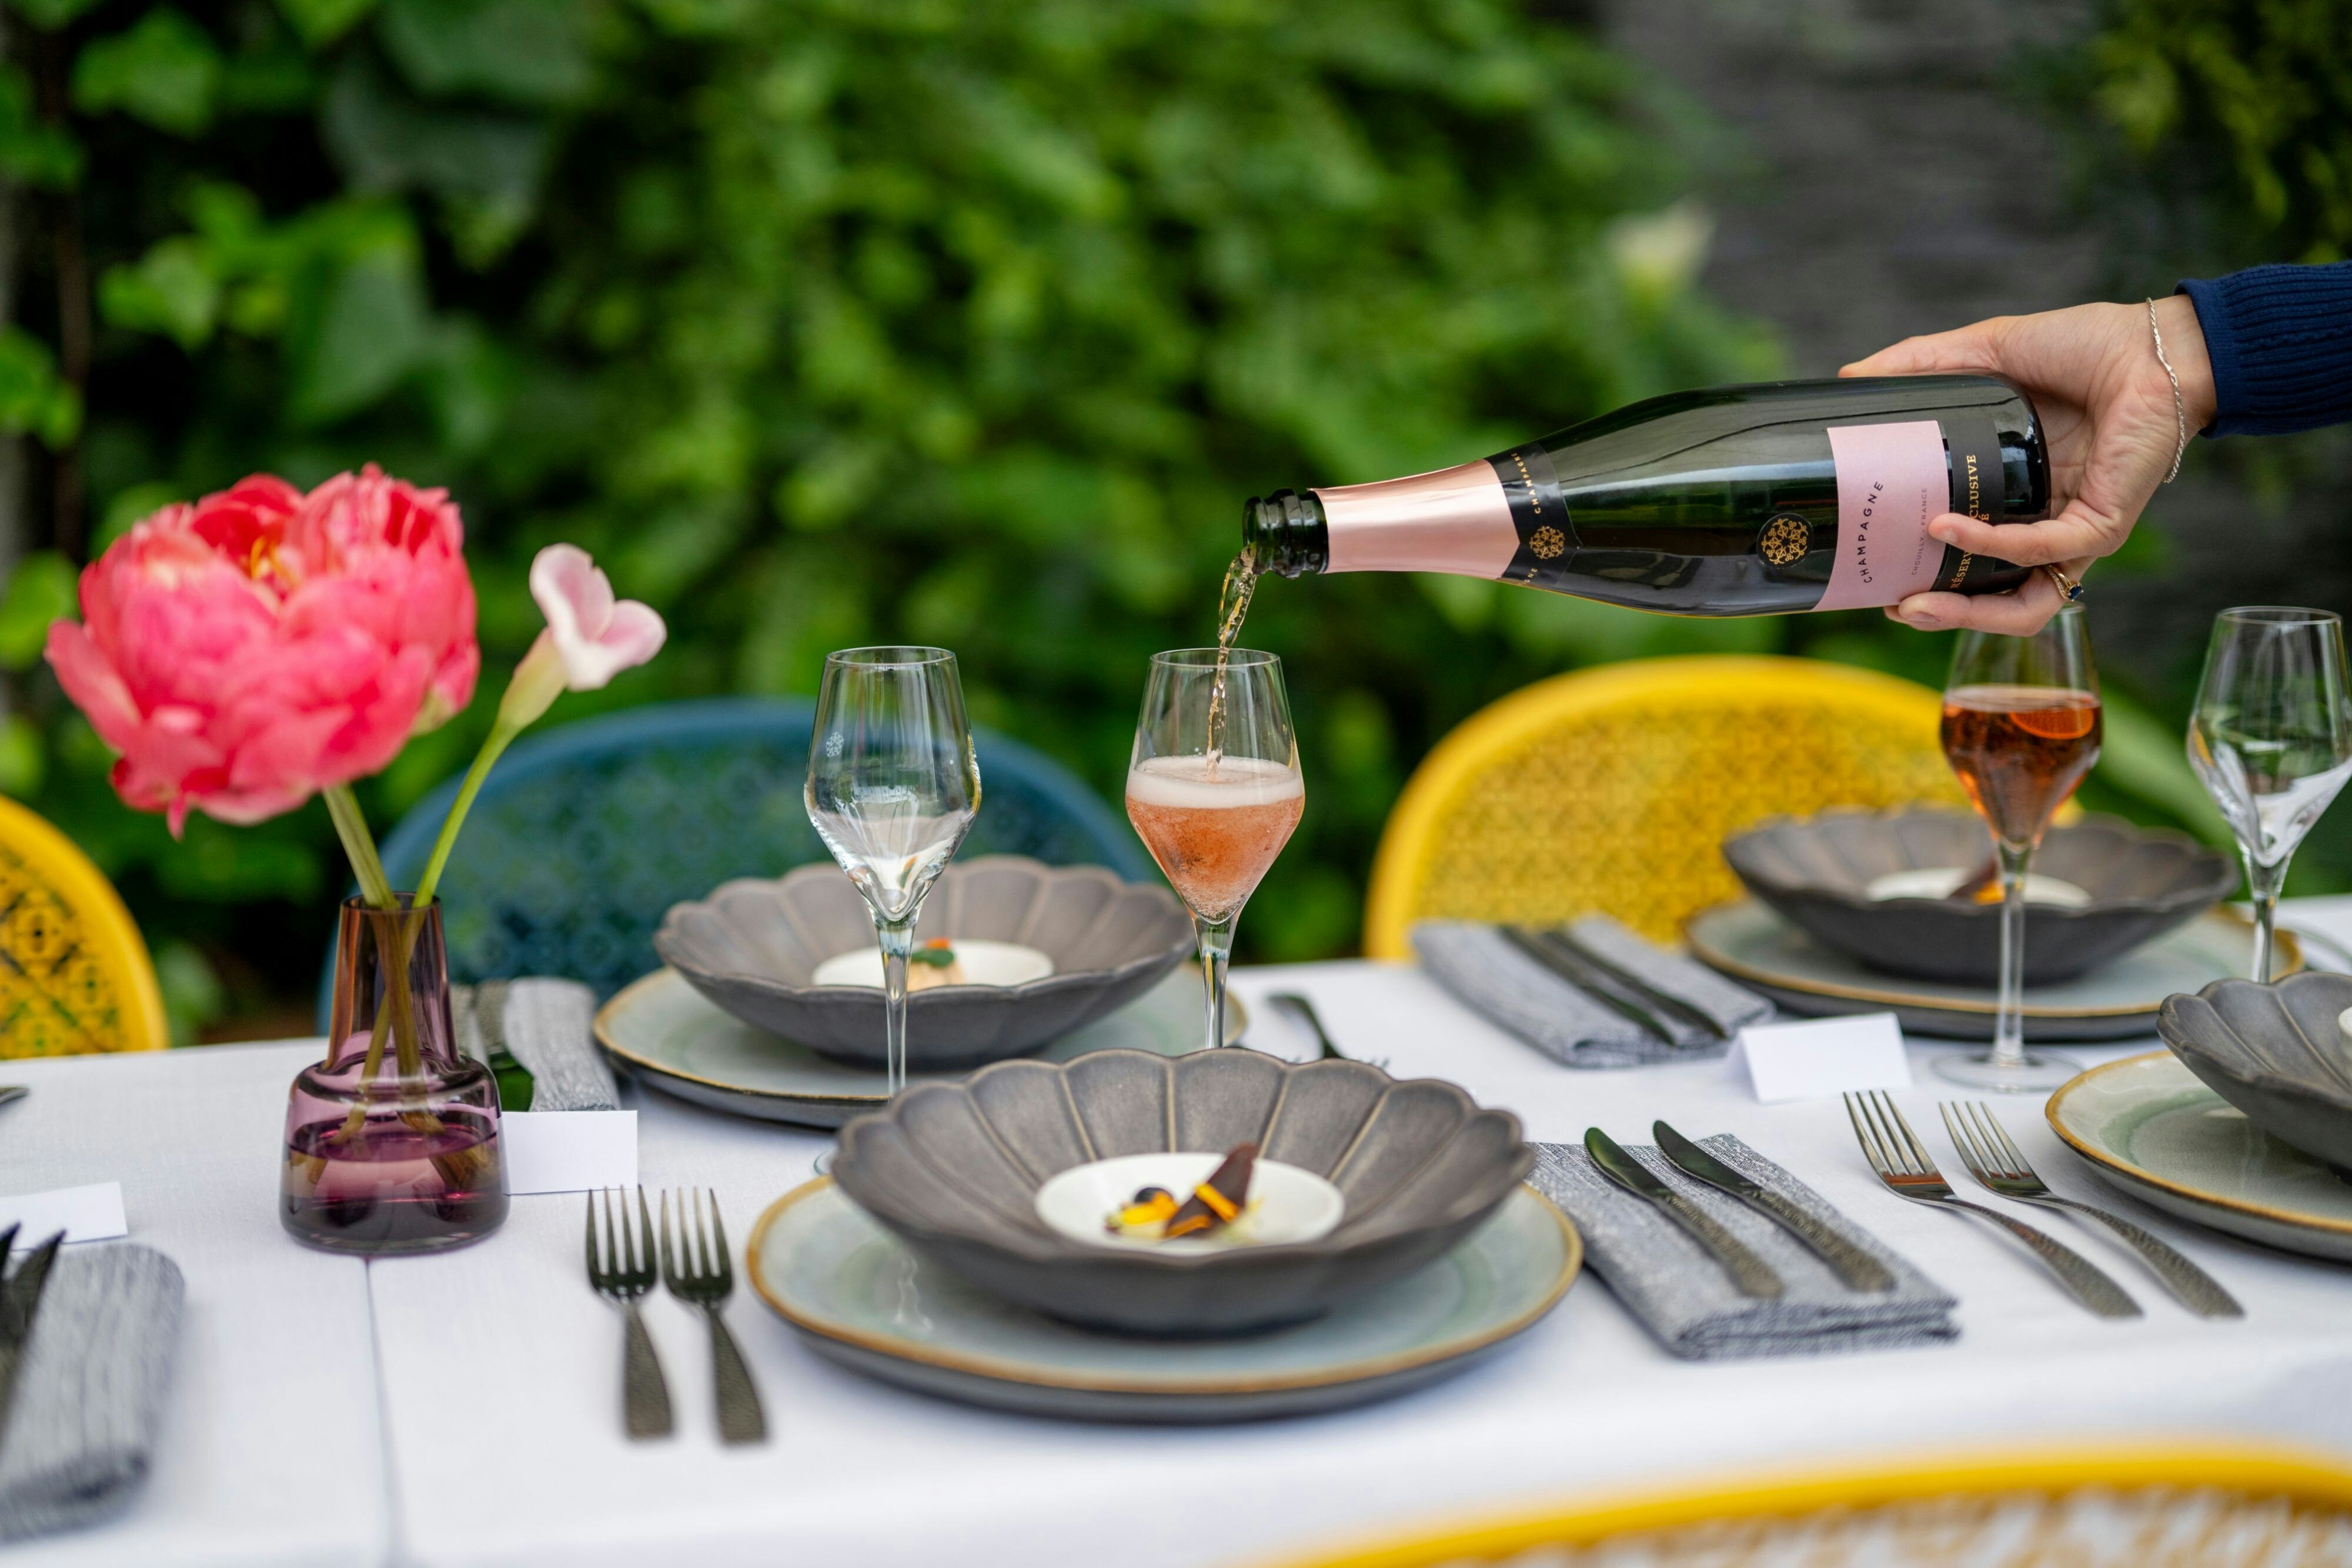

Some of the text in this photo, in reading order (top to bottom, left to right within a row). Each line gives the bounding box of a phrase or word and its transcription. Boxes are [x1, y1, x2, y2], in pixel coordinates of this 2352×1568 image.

[1511, 452, 1542, 514] CHAMPAGNE
[1950, 454, 1979, 589] RÉSERV CLUSIVE
[1857, 482, 1883, 583] CHAMPAGNE
[1912, 537, 1925, 576] CHOUILLY
